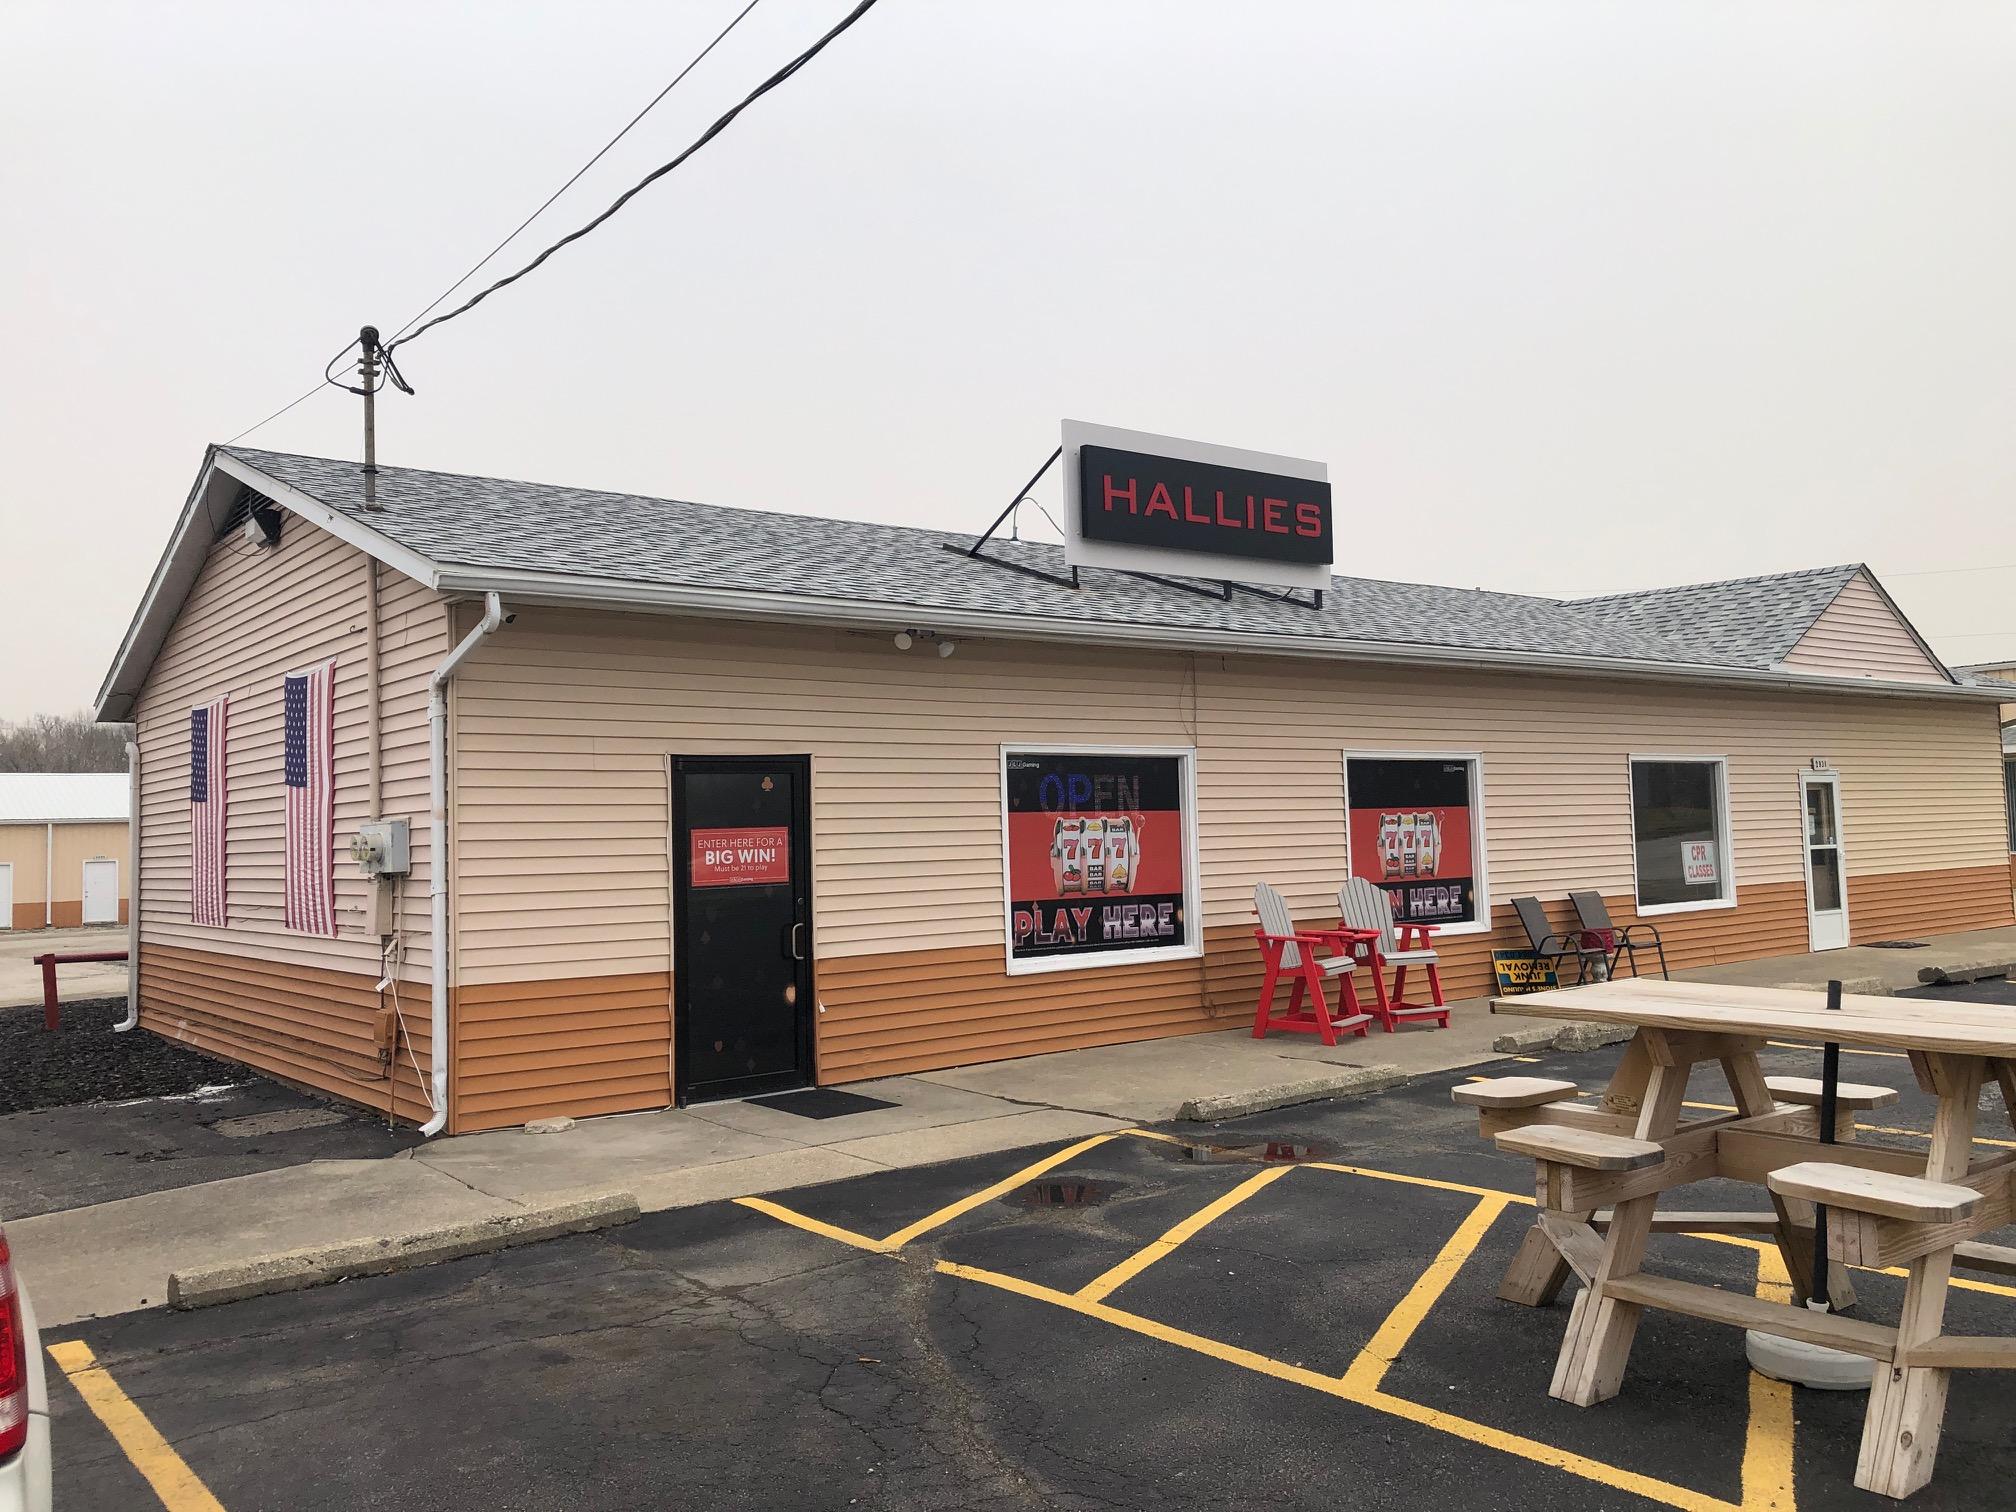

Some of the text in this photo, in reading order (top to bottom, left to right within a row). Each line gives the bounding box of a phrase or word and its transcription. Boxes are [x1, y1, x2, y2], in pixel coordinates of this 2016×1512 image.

[1103, 474, 1322, 538] HALLIES
[1040, 773, 1140, 817] OPEN
[698, 837, 783, 849] ENTER HERE FOR A
[705, 848, 776, 865] BIG WIN!
[1691, 845, 1706, 860] CPR
[731, 864, 740, 872] be
[756, 864, 768, 873] play
[1688, 864, 1713, 878] CLASSES
[1410, 885, 1463, 917] HERE
[1014, 902, 1175, 946] PLAY HERE
[1500, 962, 1550, 972] REMOVAL
[1514, 972, 1541, 981] JUNK
